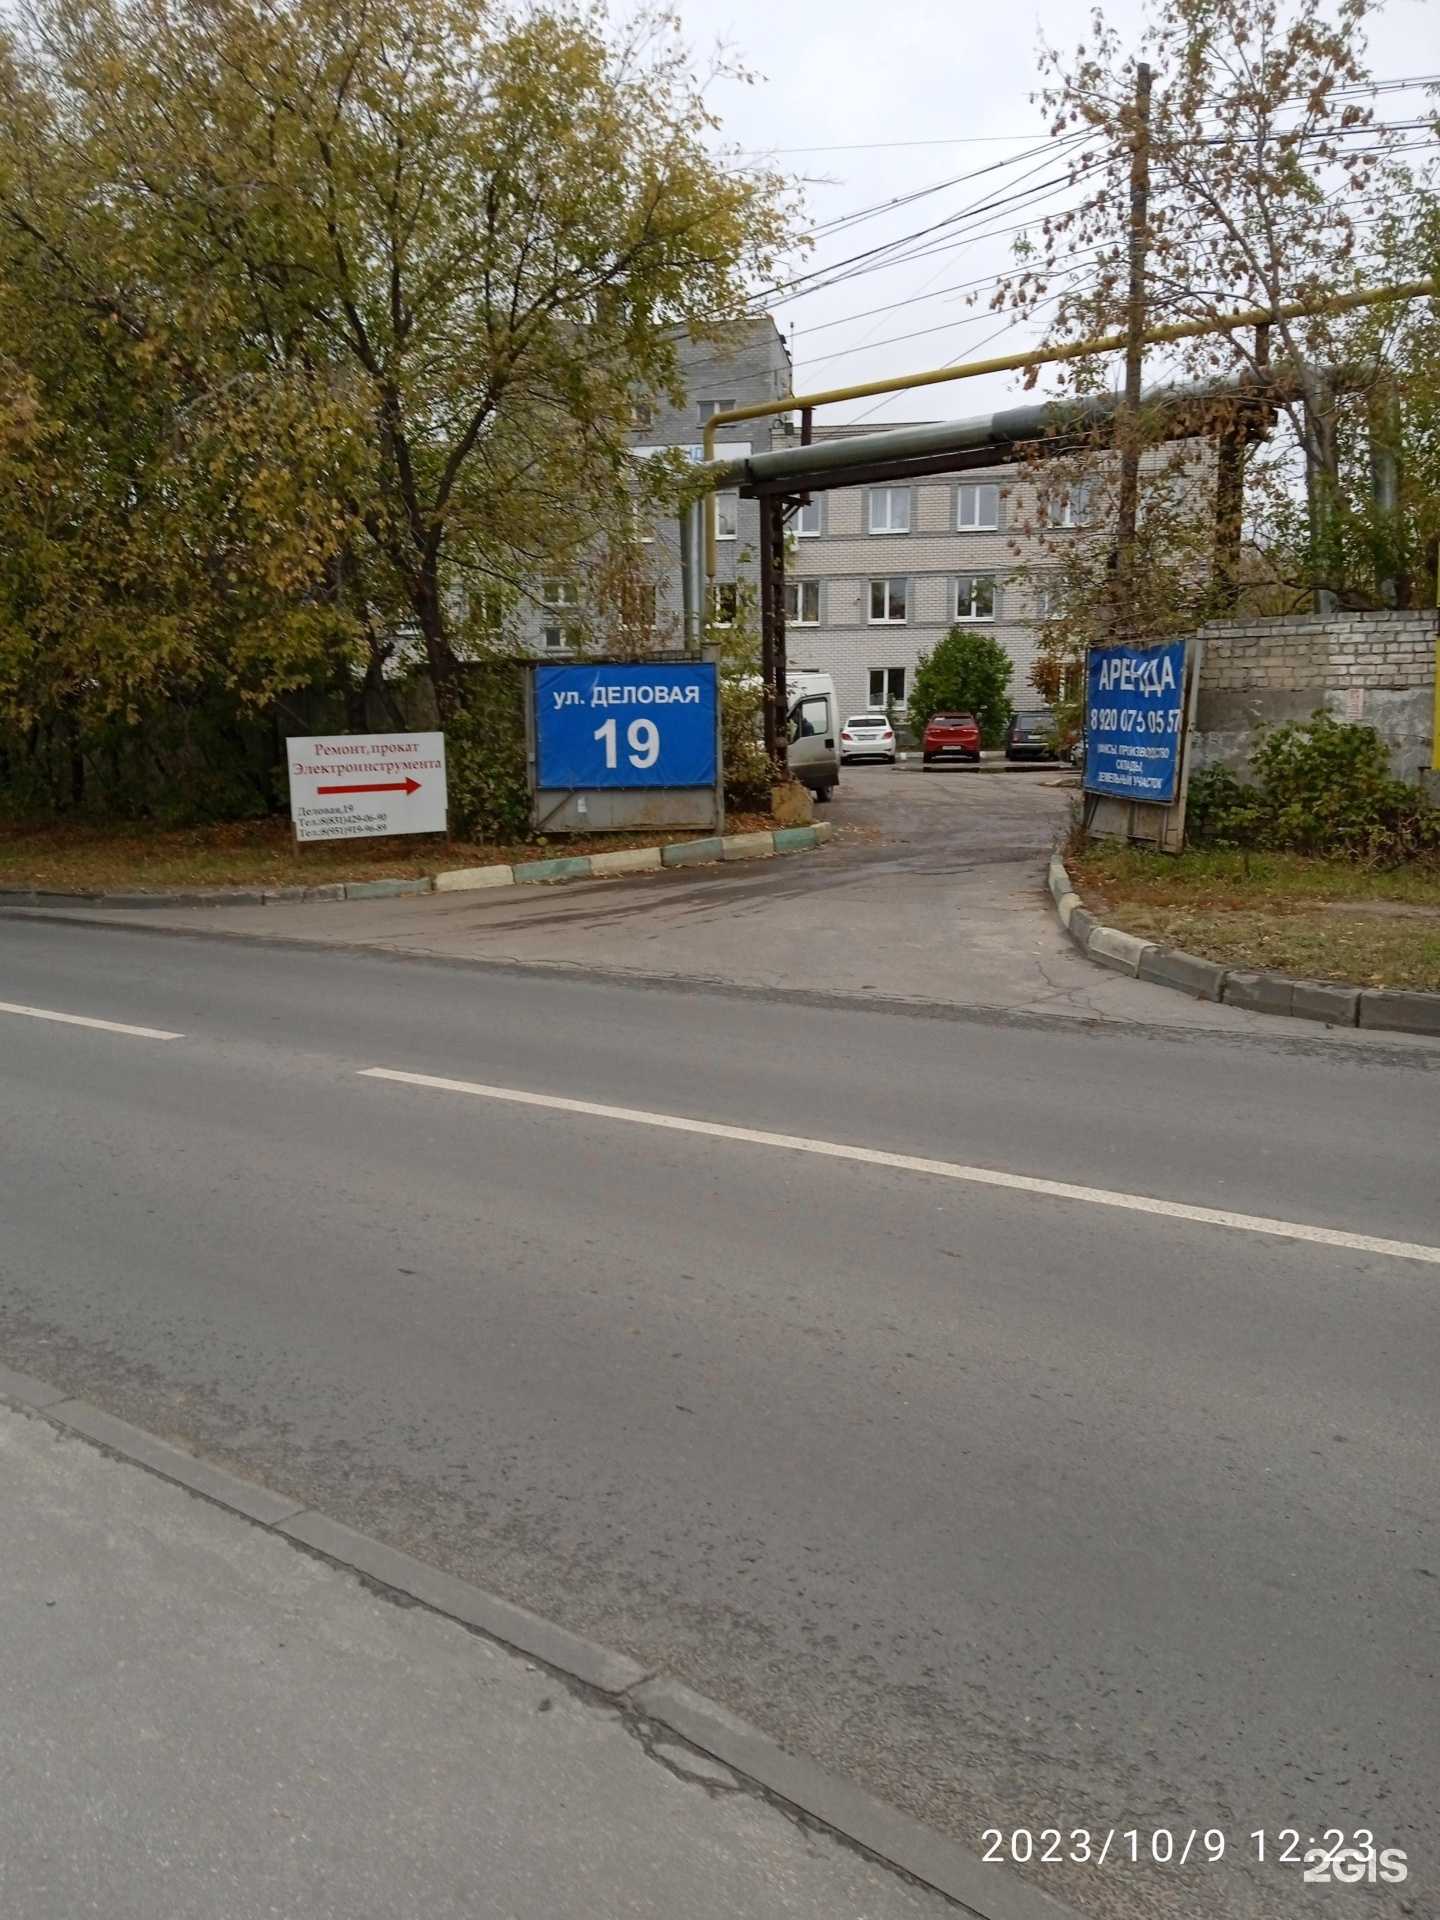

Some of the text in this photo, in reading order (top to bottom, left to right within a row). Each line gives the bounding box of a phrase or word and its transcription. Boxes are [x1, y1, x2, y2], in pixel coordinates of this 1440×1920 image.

[1099, 656, 1176, 698] АРЕНДА
[553, 686, 699, 709] ул. ДЕЛОВАЯ
[1090, 708, 1098, 730] 8
[1099, 708, 1118, 731] 920
[1148, 709, 1165, 734] 05
[593, 718, 660, 769] 19
[293, 758, 441, 776] Электроинструмента
